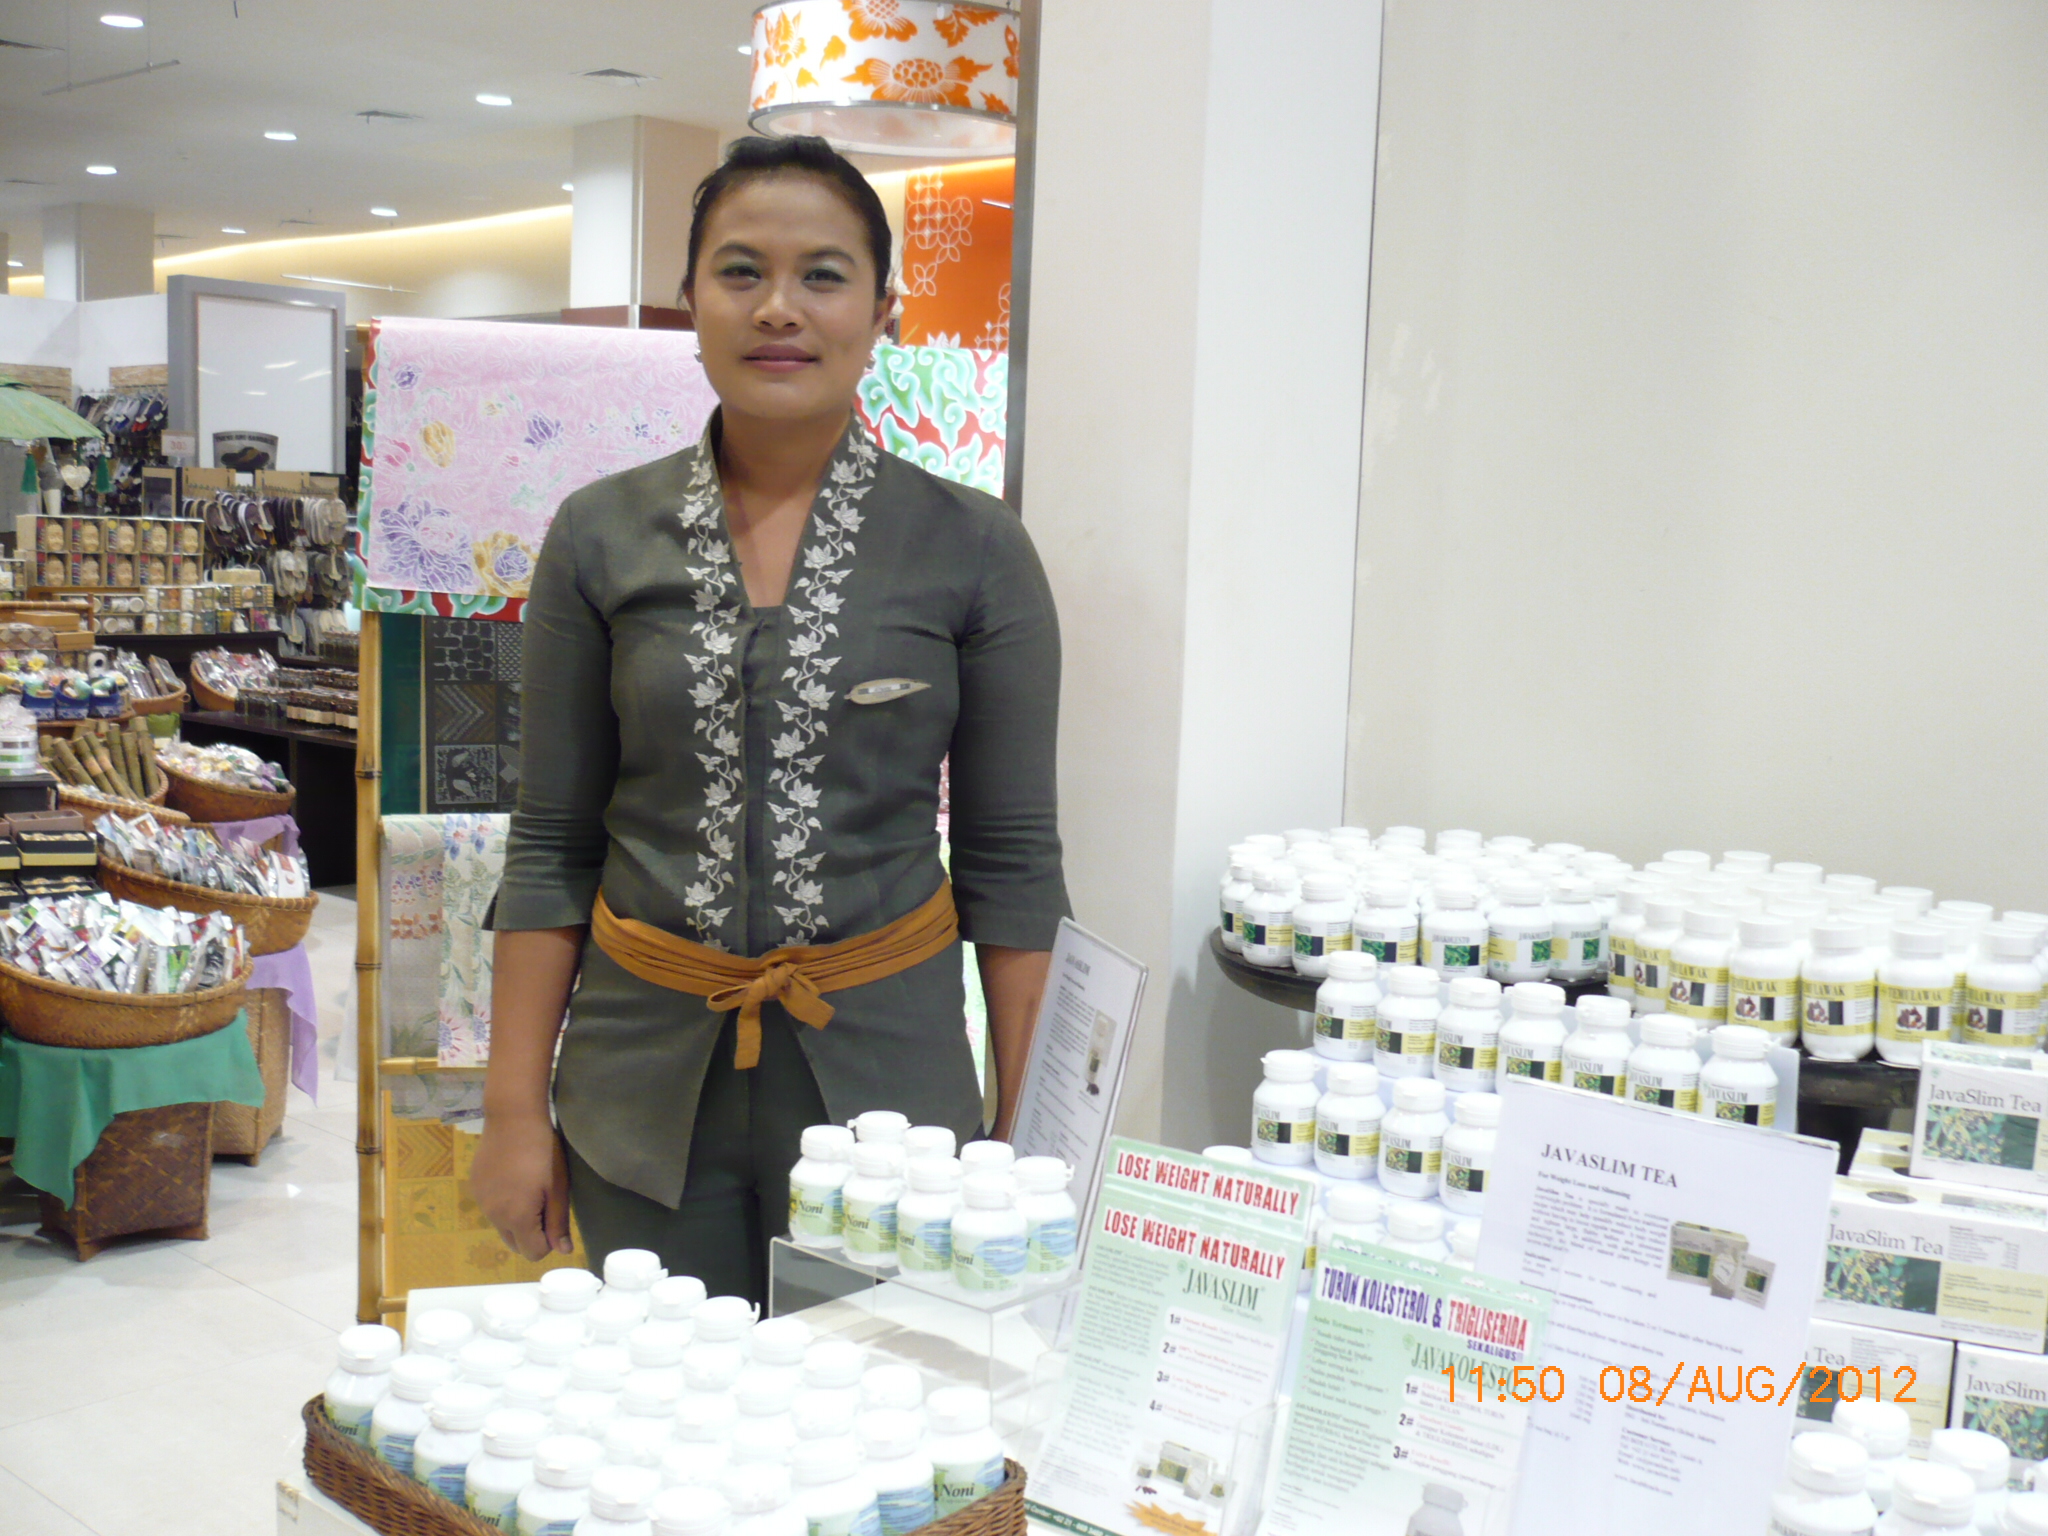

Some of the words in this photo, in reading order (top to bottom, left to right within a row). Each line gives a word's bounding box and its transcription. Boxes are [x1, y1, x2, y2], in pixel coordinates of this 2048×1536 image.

[1707, 1087, 1748, 1103] JAVASLIM
[1927, 1083, 2005, 1109] JavaSlim
[2010, 1094, 2042, 1114] Tea
[1541, 1143, 1636, 1179] JAVASLIM
[1641, 1164, 1678, 1188] TEA
[1117, 1152, 1151, 1182] LOSE
[1154, 1160, 1210, 1198] WEIGHT
[1212, 1175, 1300, 1216] NATURALLY
[799, 1200, 825, 1215] Noni
[846, 1214, 870, 1230] Noni
[1104, 1208, 1138, 1240] LOSE
[1141, 1218, 1197, 1256] WEIGHT
[1199, 1235, 1286, 1281] NATURALLY
[1827, 1222, 1906, 1251] JavaSlim
[1911, 1235, 1944, 1256] Tea
[1183, 1268, 1260, 1311] JAVASLIM
[1322, 1267, 1360, 1307] TURUN
[1360, 1276, 1431, 1325] KOLESTEROL
[1432, 1297, 1443, 1329] &
[1448, 1300, 1528, 1351] TRIGLISERIDA
[1814, 1346, 1846, 1366] Tea
[1966, 1373, 2047, 1402] JavaSlim
[939, 1481, 975, 1500] Noni
